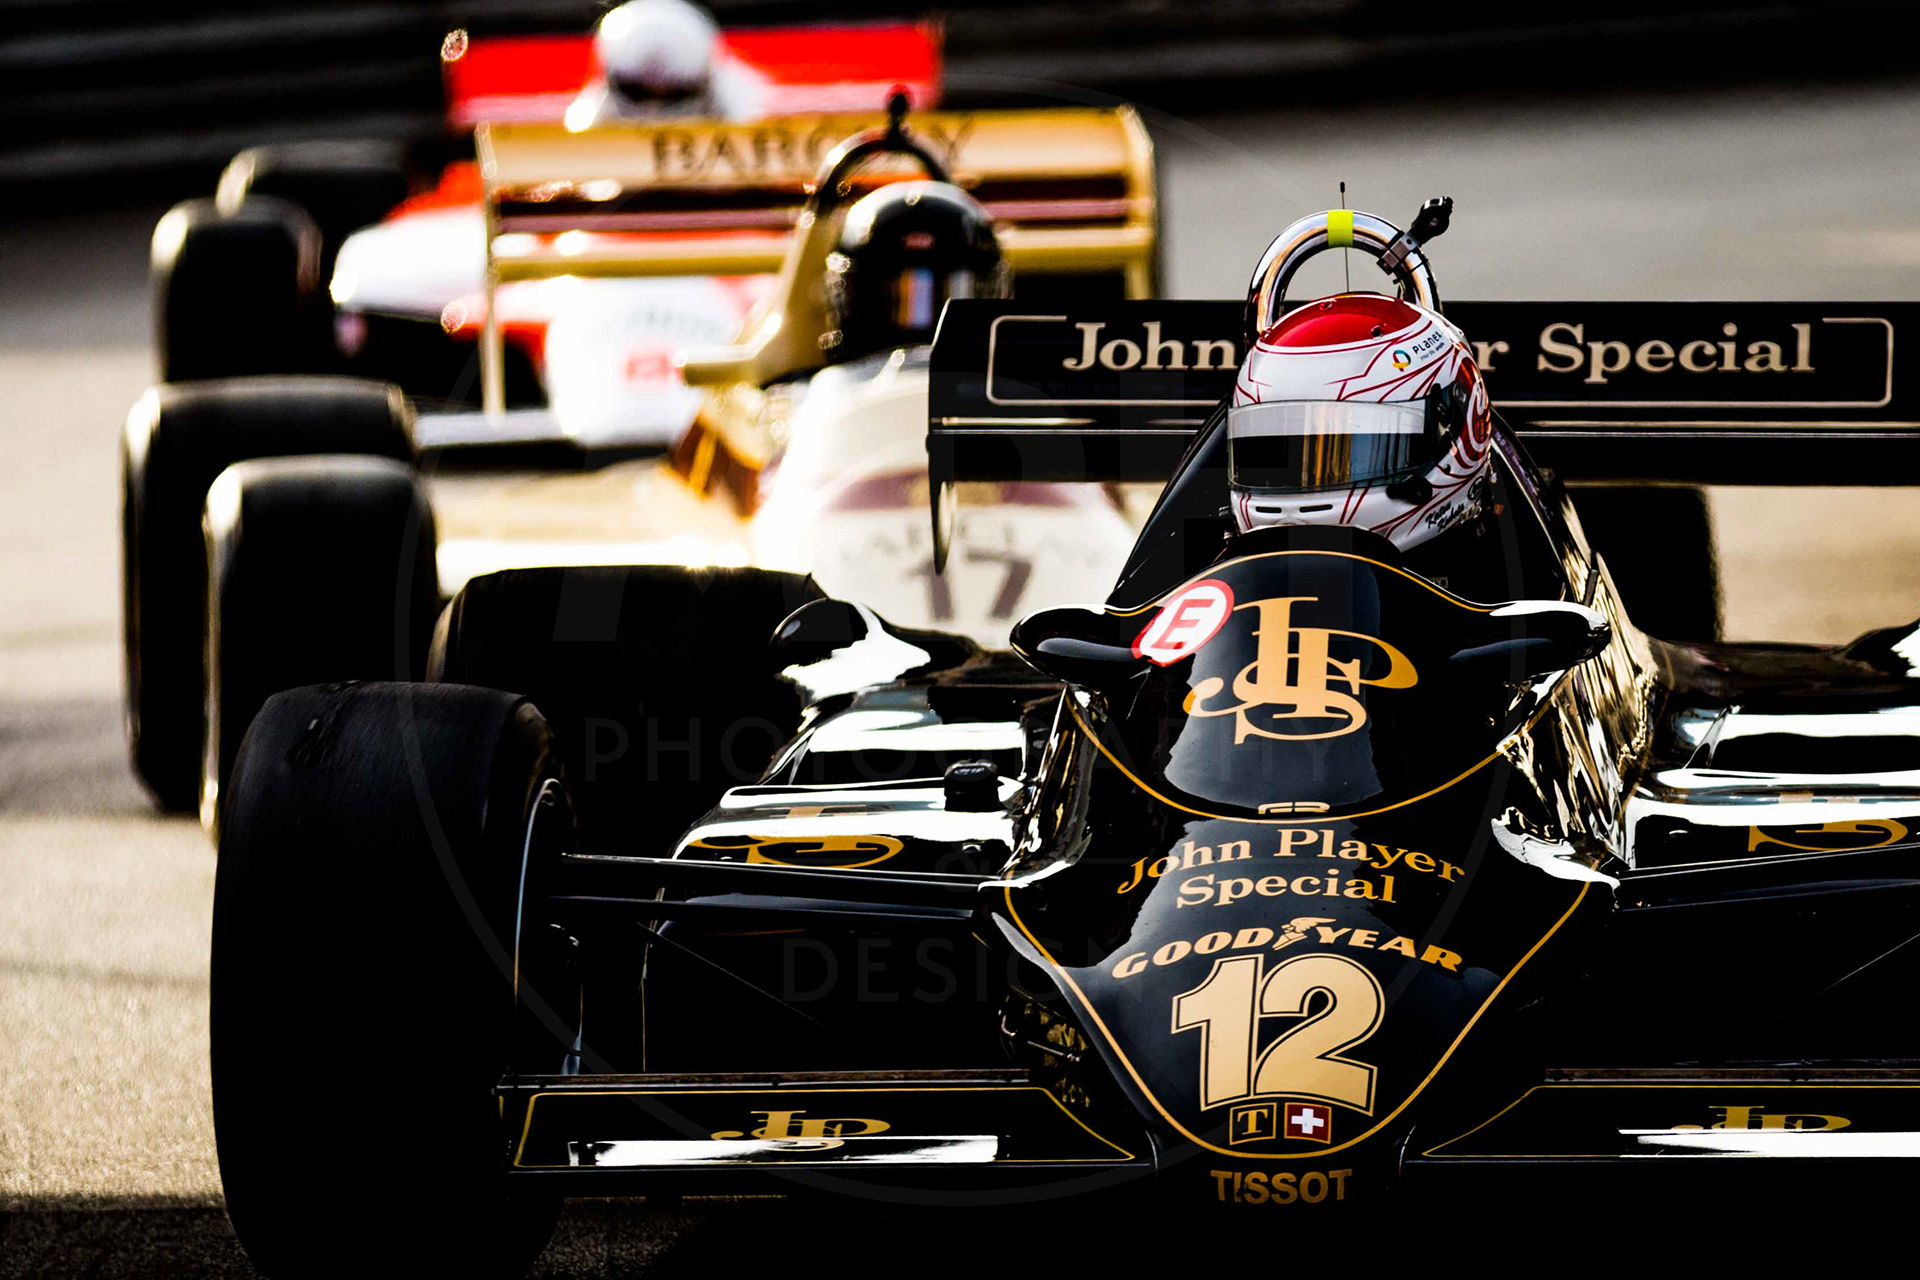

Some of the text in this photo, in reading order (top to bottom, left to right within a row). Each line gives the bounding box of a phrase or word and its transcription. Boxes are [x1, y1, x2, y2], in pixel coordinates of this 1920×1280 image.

[651, 113, 973, 180] BARCY
[1062, 320, 1238, 371] John
[1537, 322, 1816, 384] Special
[902, 547, 1033, 623] 17
[1117, 829, 1466, 895] John Player
[1176, 869, 1397, 909] Special
[1171, 952, 1386, 1117] 12
[1237, 1108, 1269, 1136] T
[1210, 1168, 1353, 1205] TISSOT
